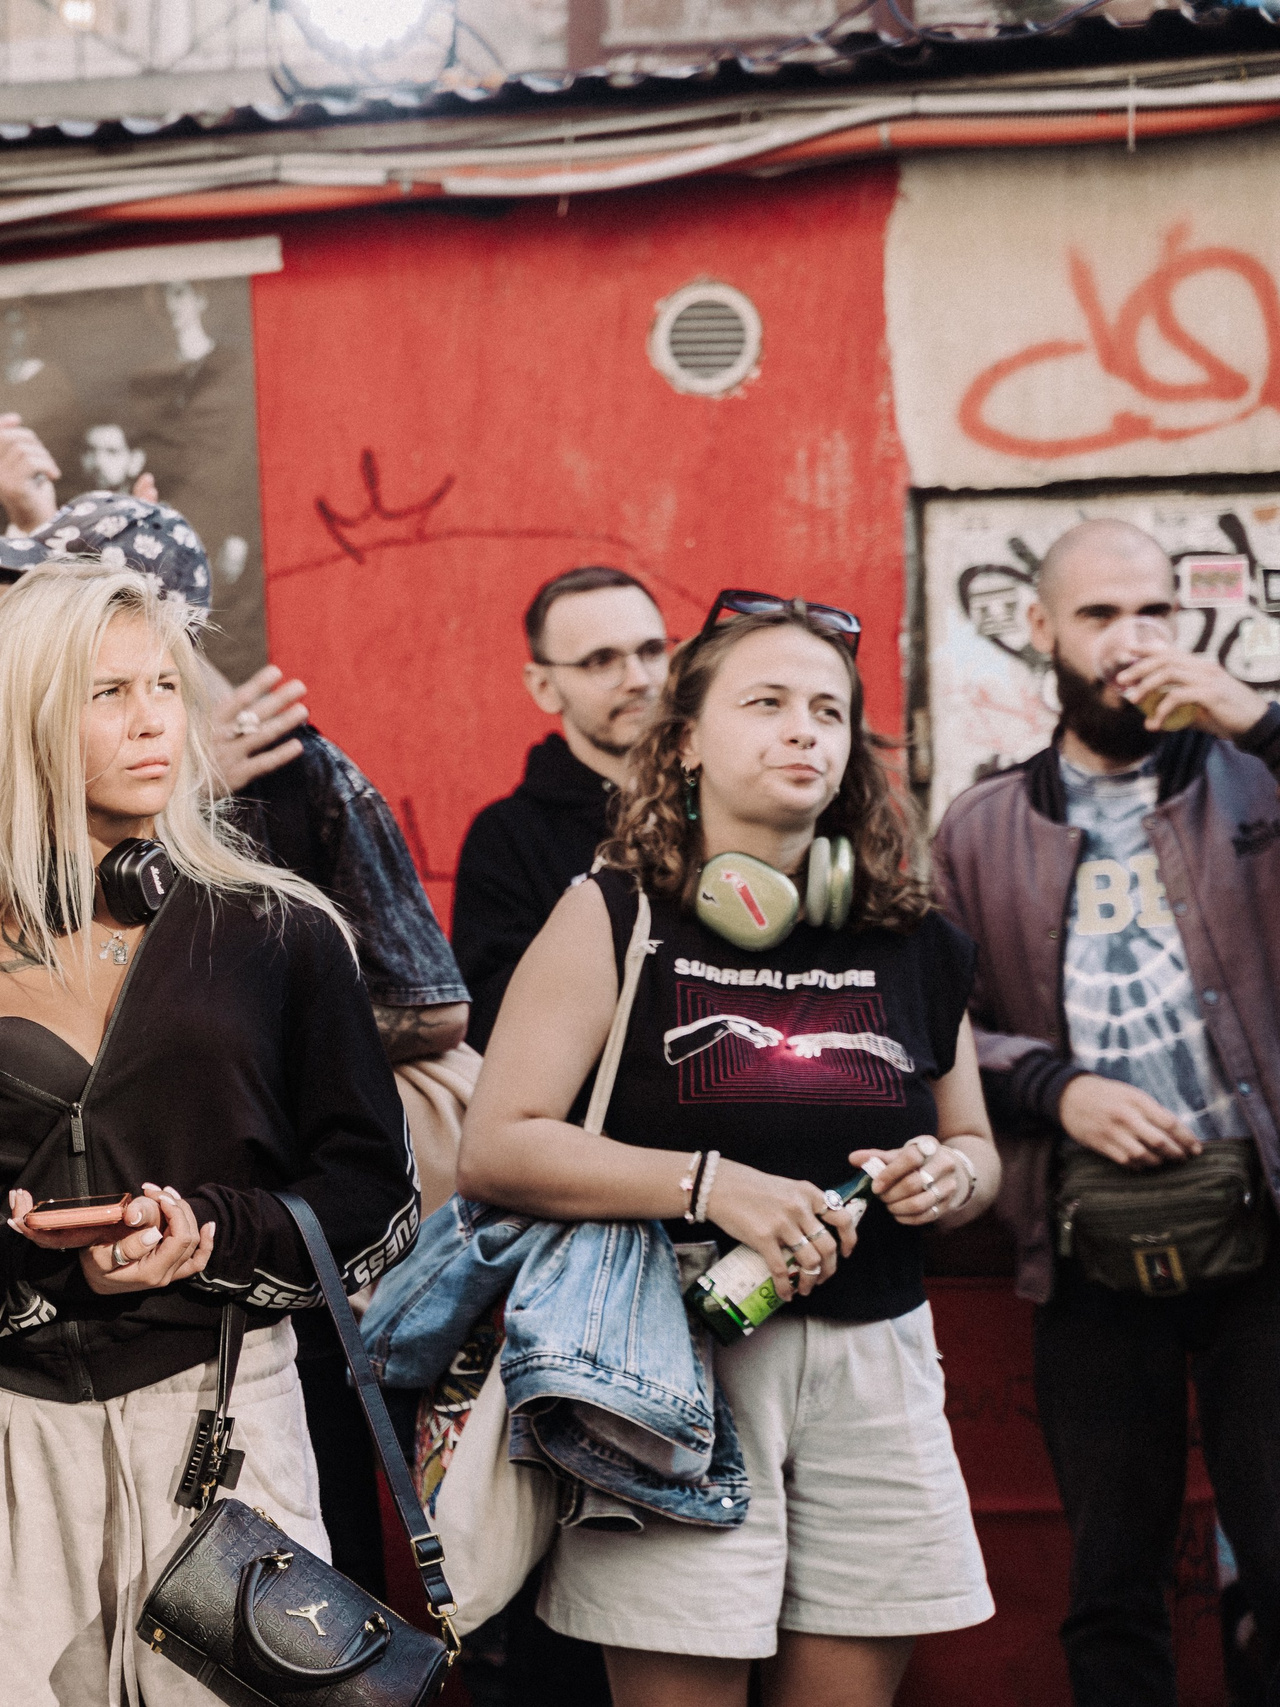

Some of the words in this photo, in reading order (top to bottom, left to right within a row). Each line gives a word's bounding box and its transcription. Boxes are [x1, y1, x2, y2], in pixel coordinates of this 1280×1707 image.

[674, 957, 783, 990] SURREAL
[785, 968, 876, 990] FUTURE
[354, 1204, 419, 1287] GUESS
